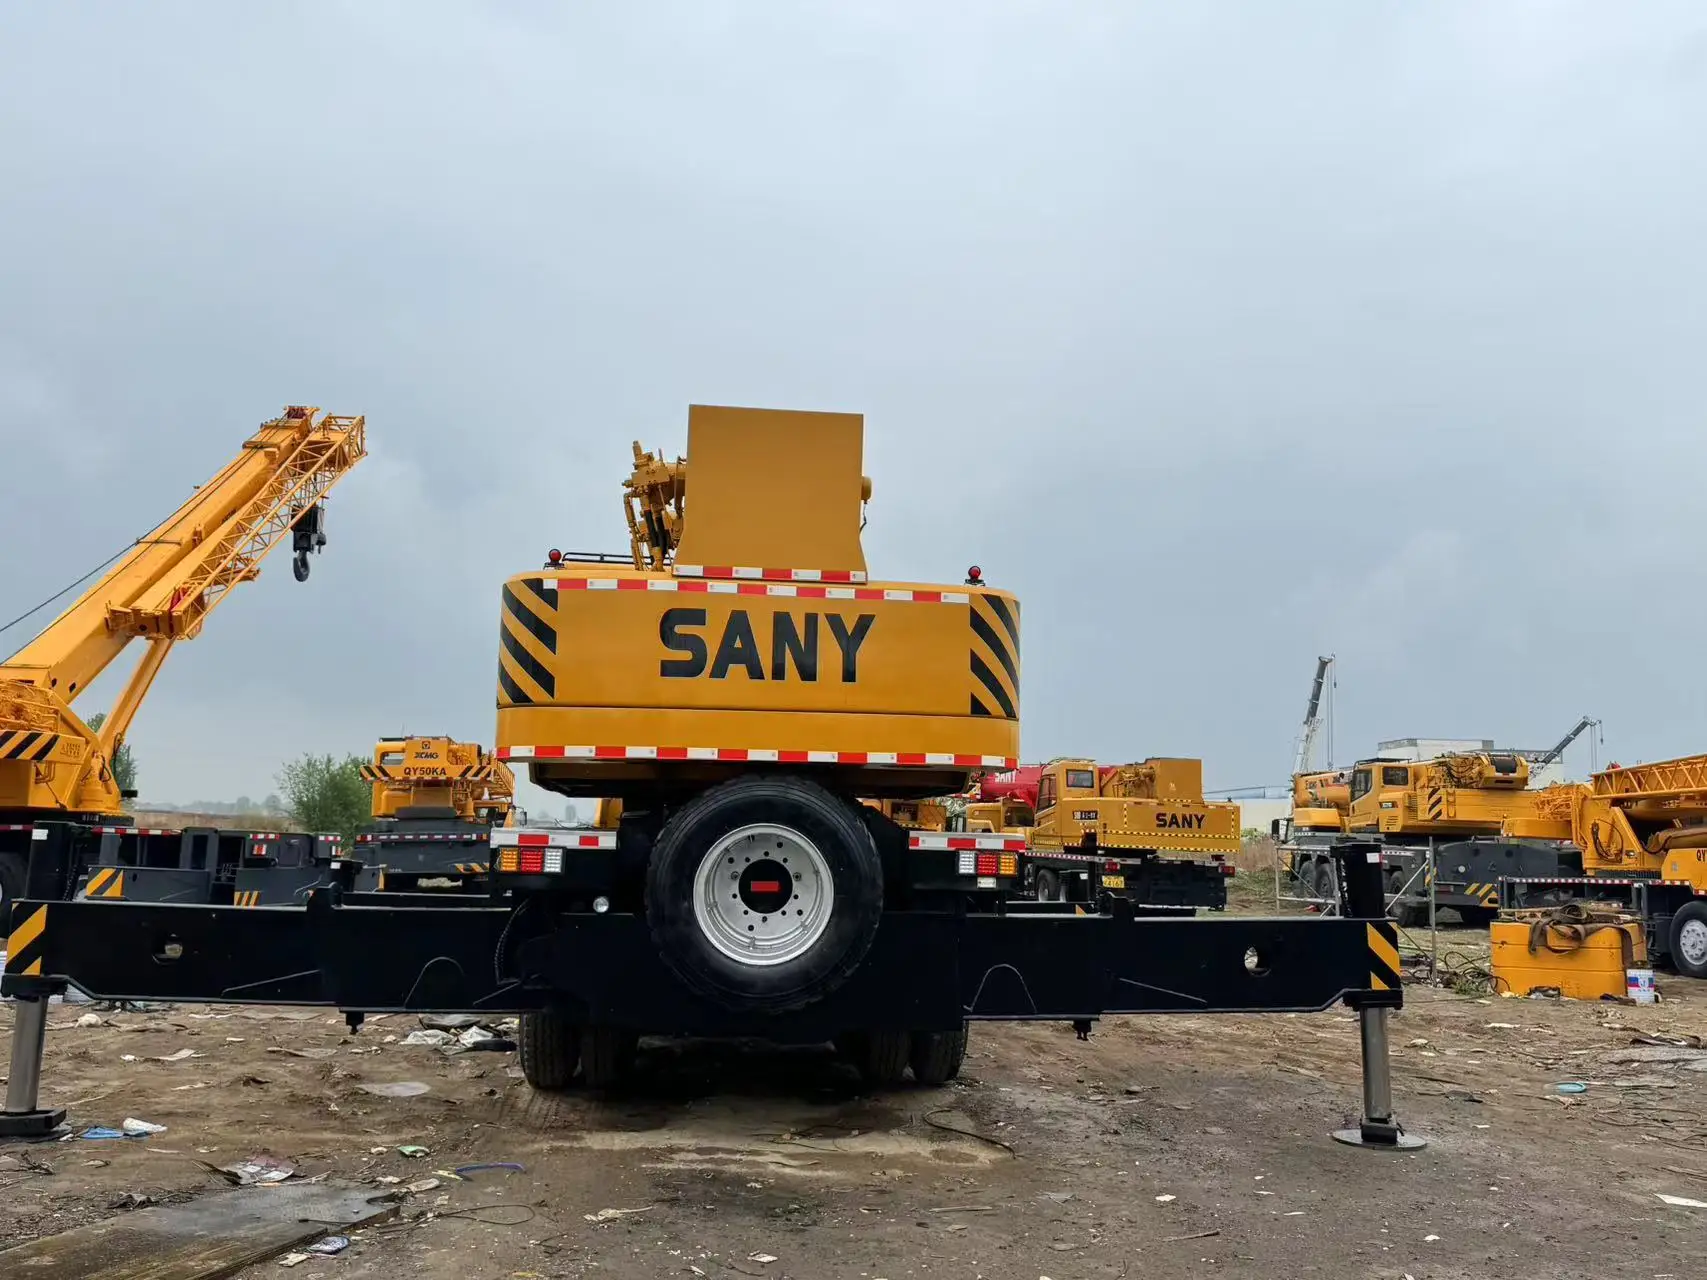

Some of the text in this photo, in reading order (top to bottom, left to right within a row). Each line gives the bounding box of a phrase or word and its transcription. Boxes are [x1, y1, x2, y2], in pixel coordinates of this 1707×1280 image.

[659, 607, 876, 683] SANY
[403, 766, 447, 776] QY50KA
[1155, 812, 1206, 829] SANY
